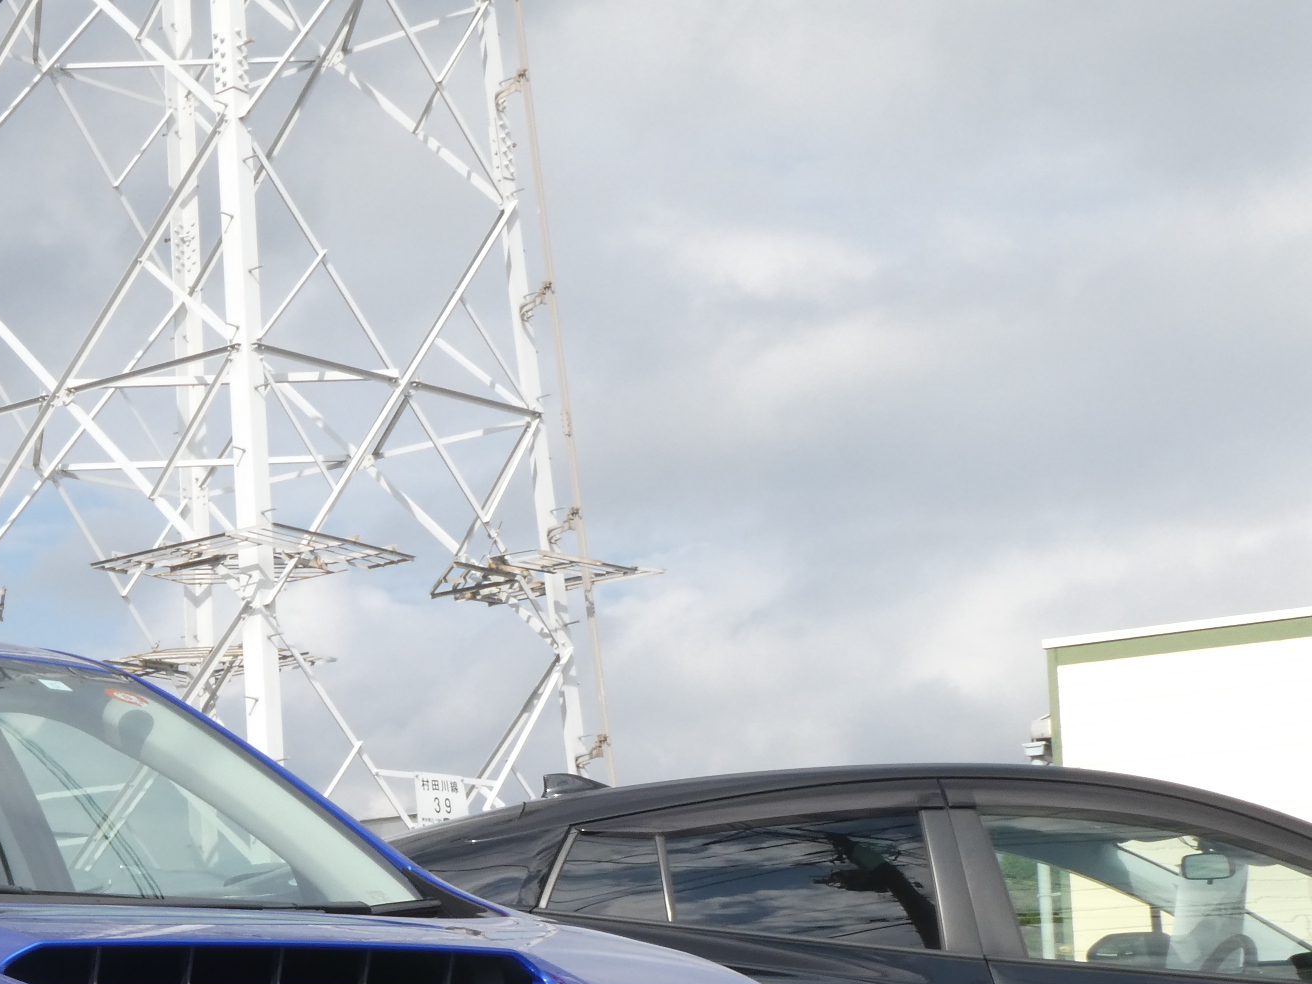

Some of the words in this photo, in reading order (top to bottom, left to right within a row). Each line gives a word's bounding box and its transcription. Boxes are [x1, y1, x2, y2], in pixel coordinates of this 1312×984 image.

[421, 778, 459, 794] 村田川線
[433, 797, 451, 814] 39
